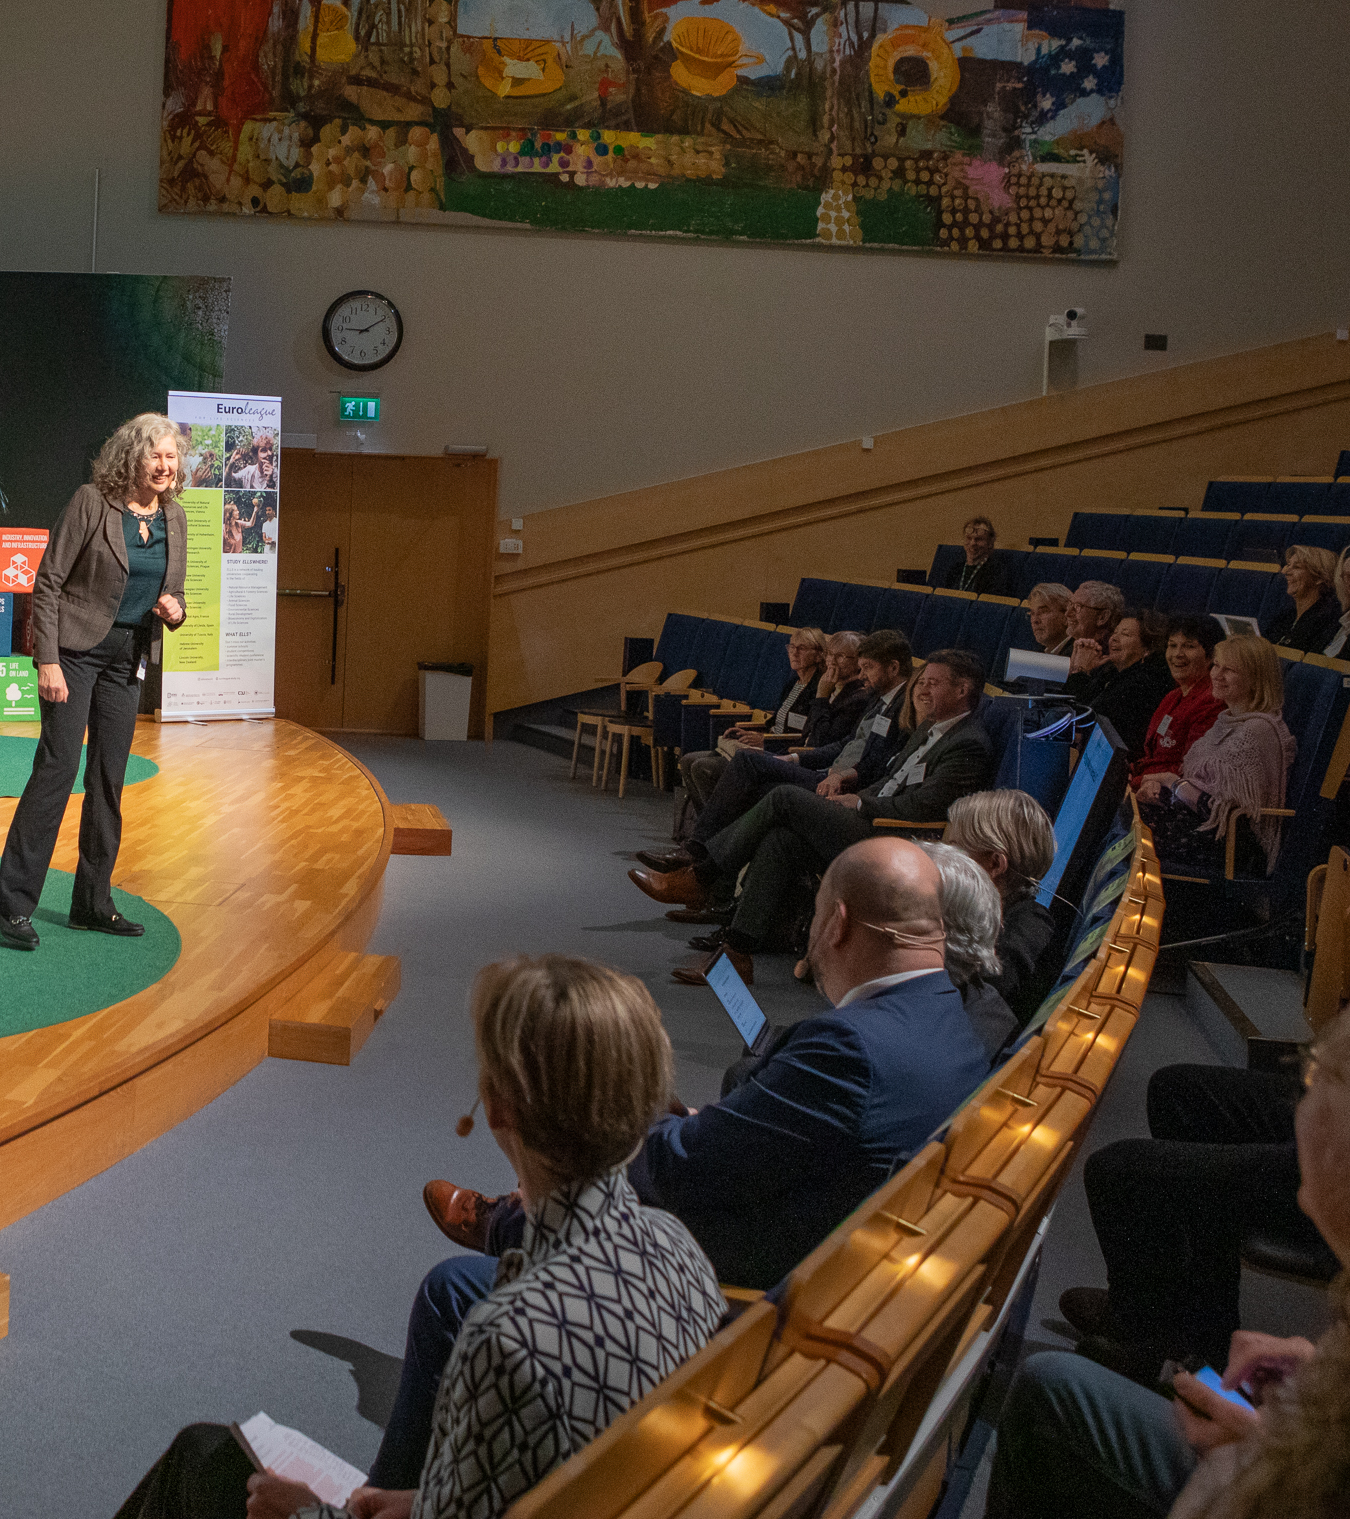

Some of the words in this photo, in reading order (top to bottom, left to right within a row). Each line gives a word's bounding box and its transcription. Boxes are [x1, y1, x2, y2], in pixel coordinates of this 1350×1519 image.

[360, 304, 369, 312] 12
[217, 402, 276, 421] Euroleague
[9, 662, 19, 670] LIFE
